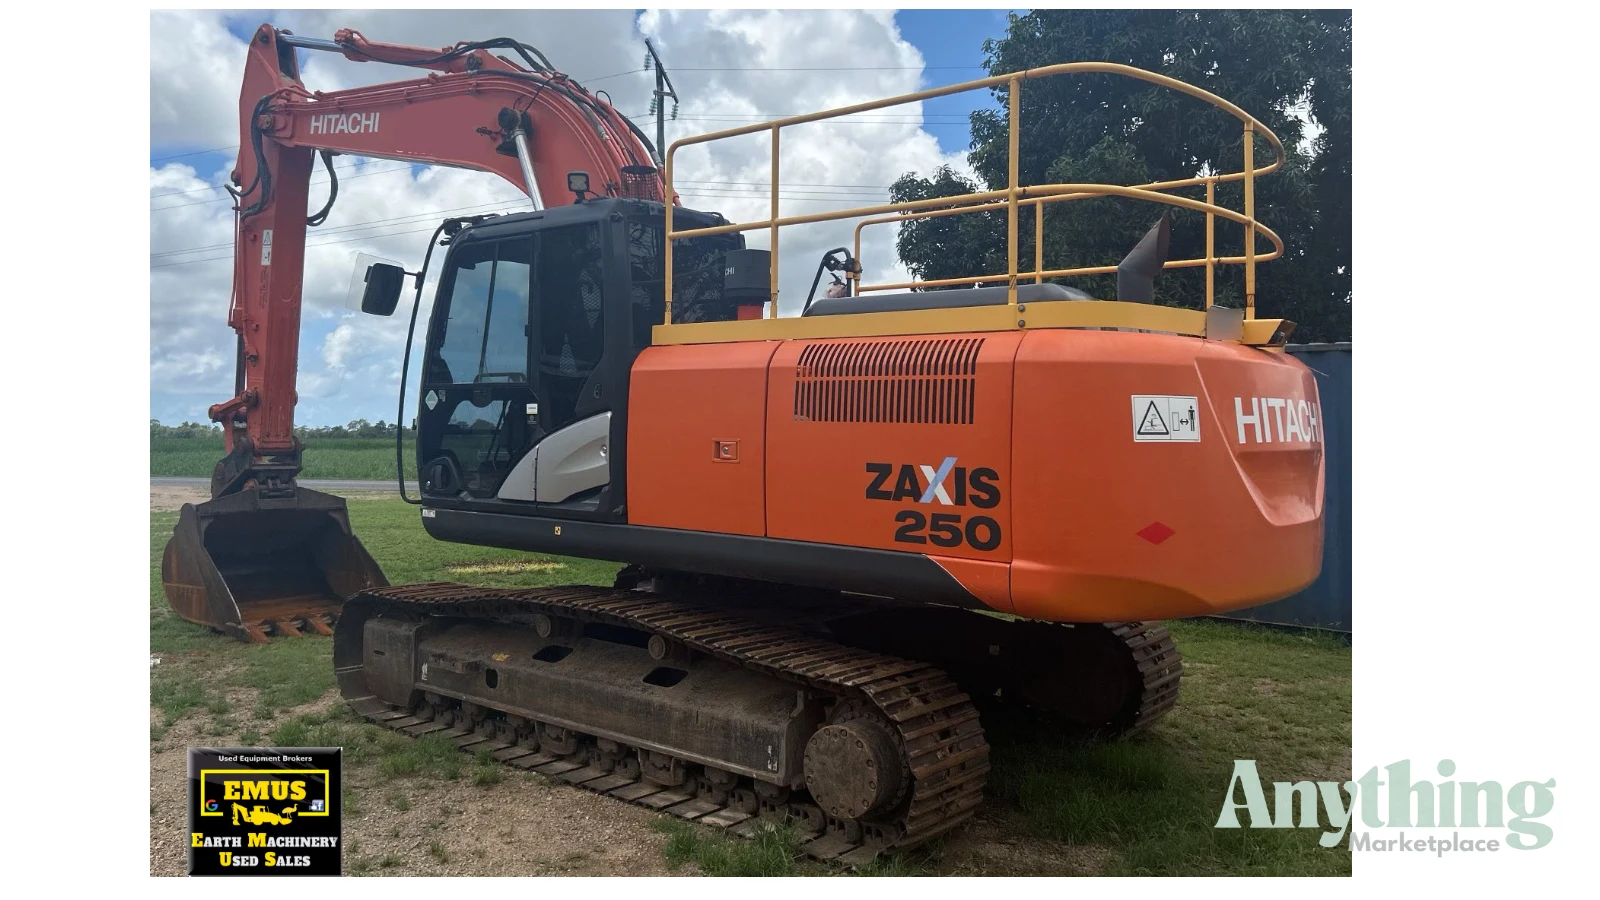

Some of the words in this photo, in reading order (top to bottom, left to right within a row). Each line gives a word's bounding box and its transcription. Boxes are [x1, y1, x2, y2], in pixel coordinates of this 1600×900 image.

[310, 112, 380, 135] HITACHI
[865, 456, 1001, 509] ZAXIS
[894, 510, 1002, 552] 250
